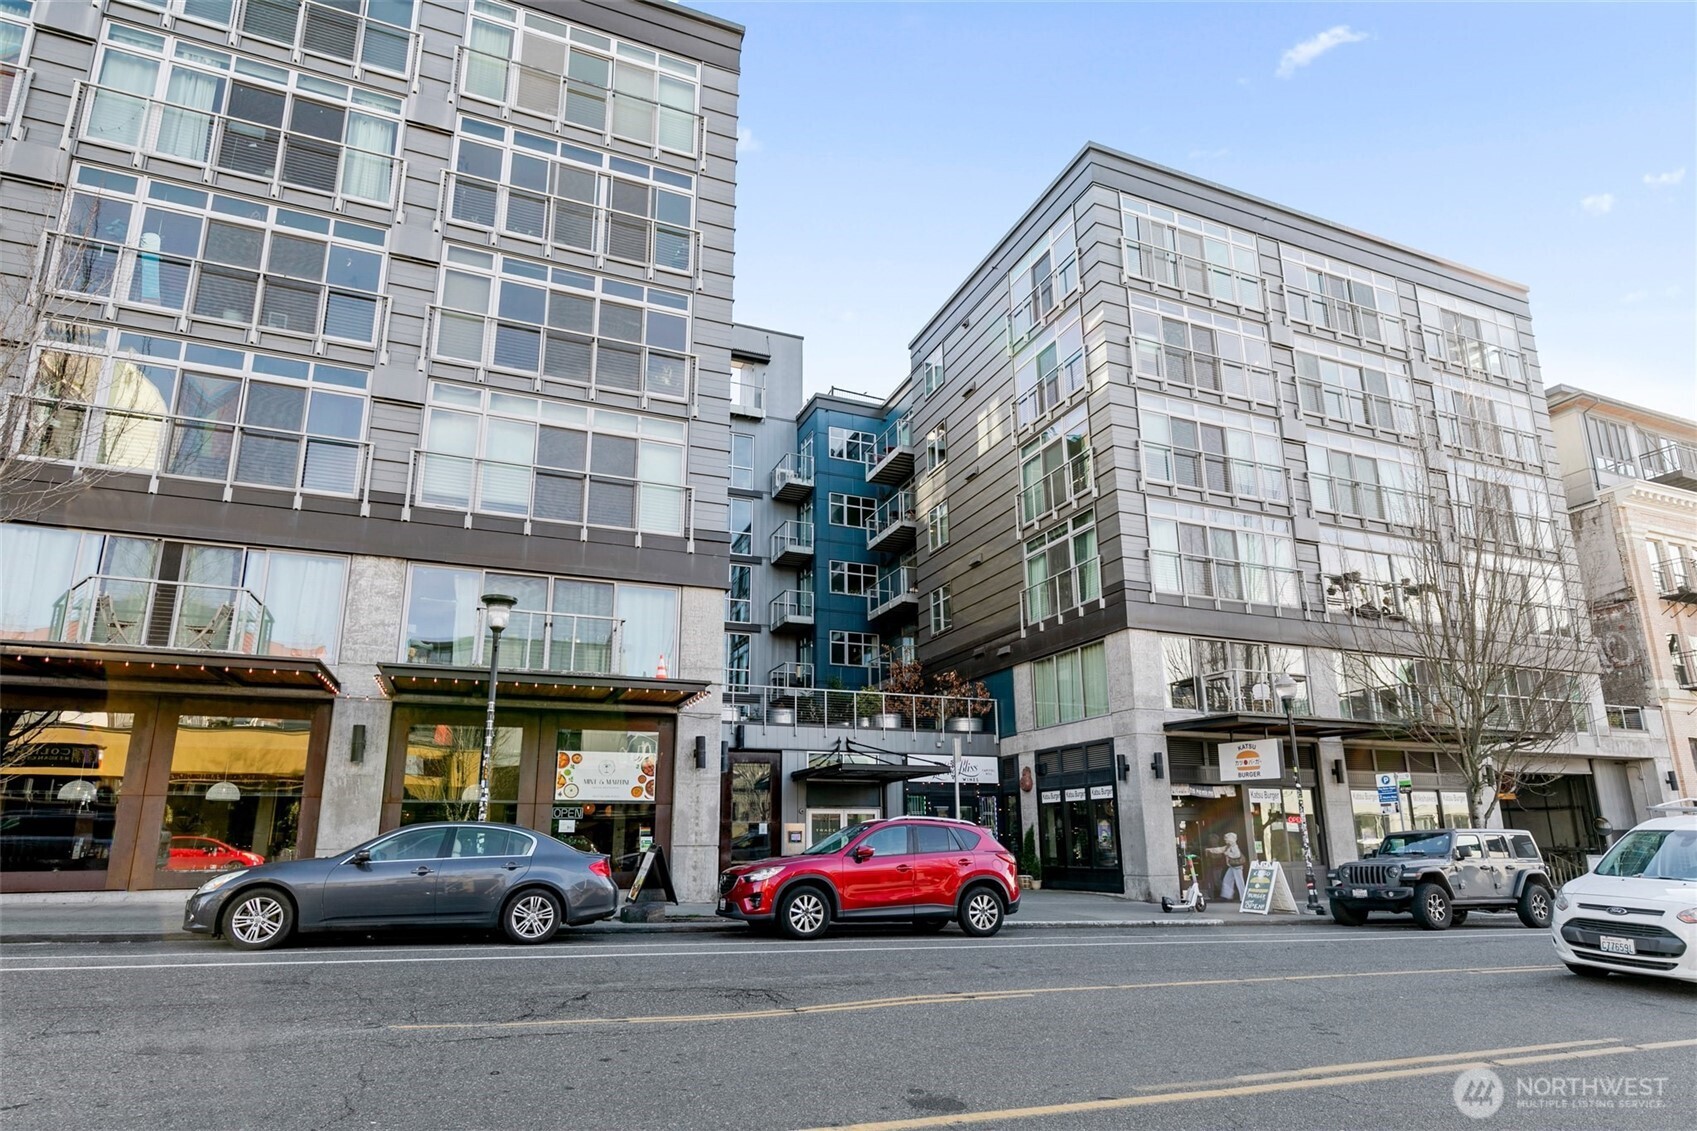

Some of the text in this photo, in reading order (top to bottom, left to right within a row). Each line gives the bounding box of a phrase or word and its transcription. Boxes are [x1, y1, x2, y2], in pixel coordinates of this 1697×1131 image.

[1251, 790, 1280, 801] Katsu Burger
[553, 808, 581, 818] OPEN
